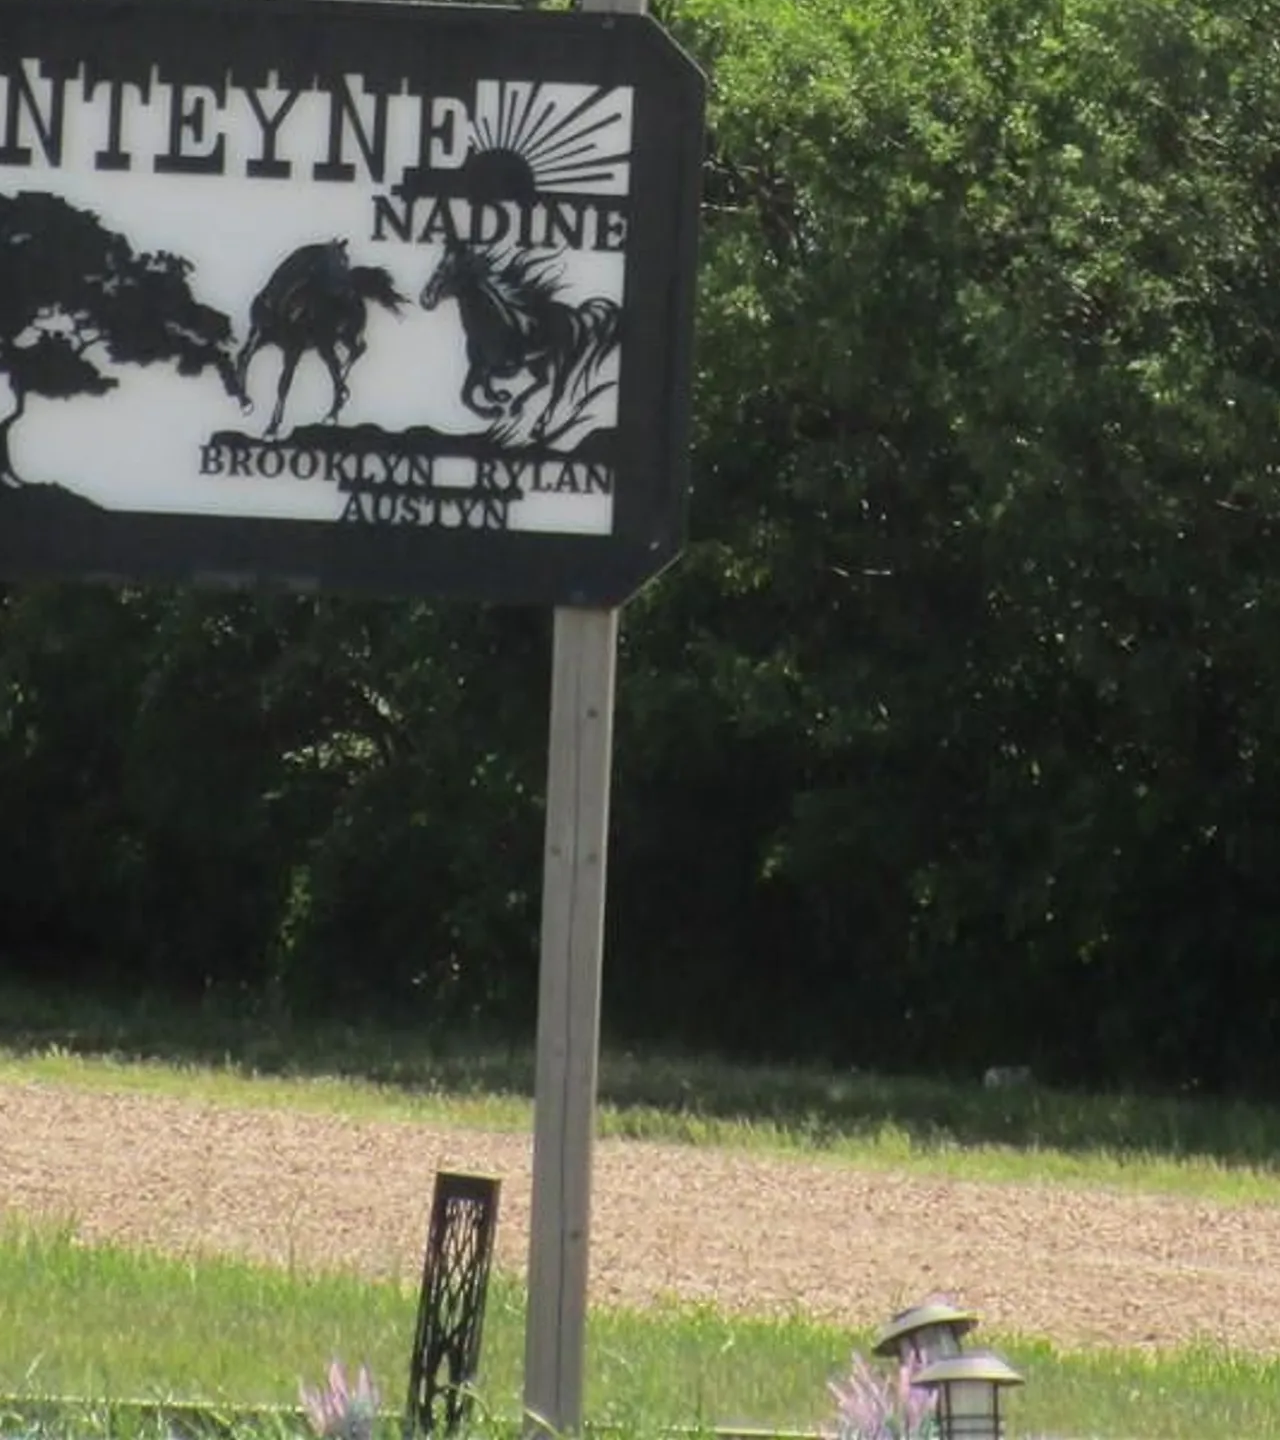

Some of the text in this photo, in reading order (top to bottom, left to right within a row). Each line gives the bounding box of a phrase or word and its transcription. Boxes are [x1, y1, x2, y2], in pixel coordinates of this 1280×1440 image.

[371, 194, 627, 252] NADINE
[198, 444, 612, 496] BROOKLYN RYLAN
[341, 490, 509, 529] AUSTYN
